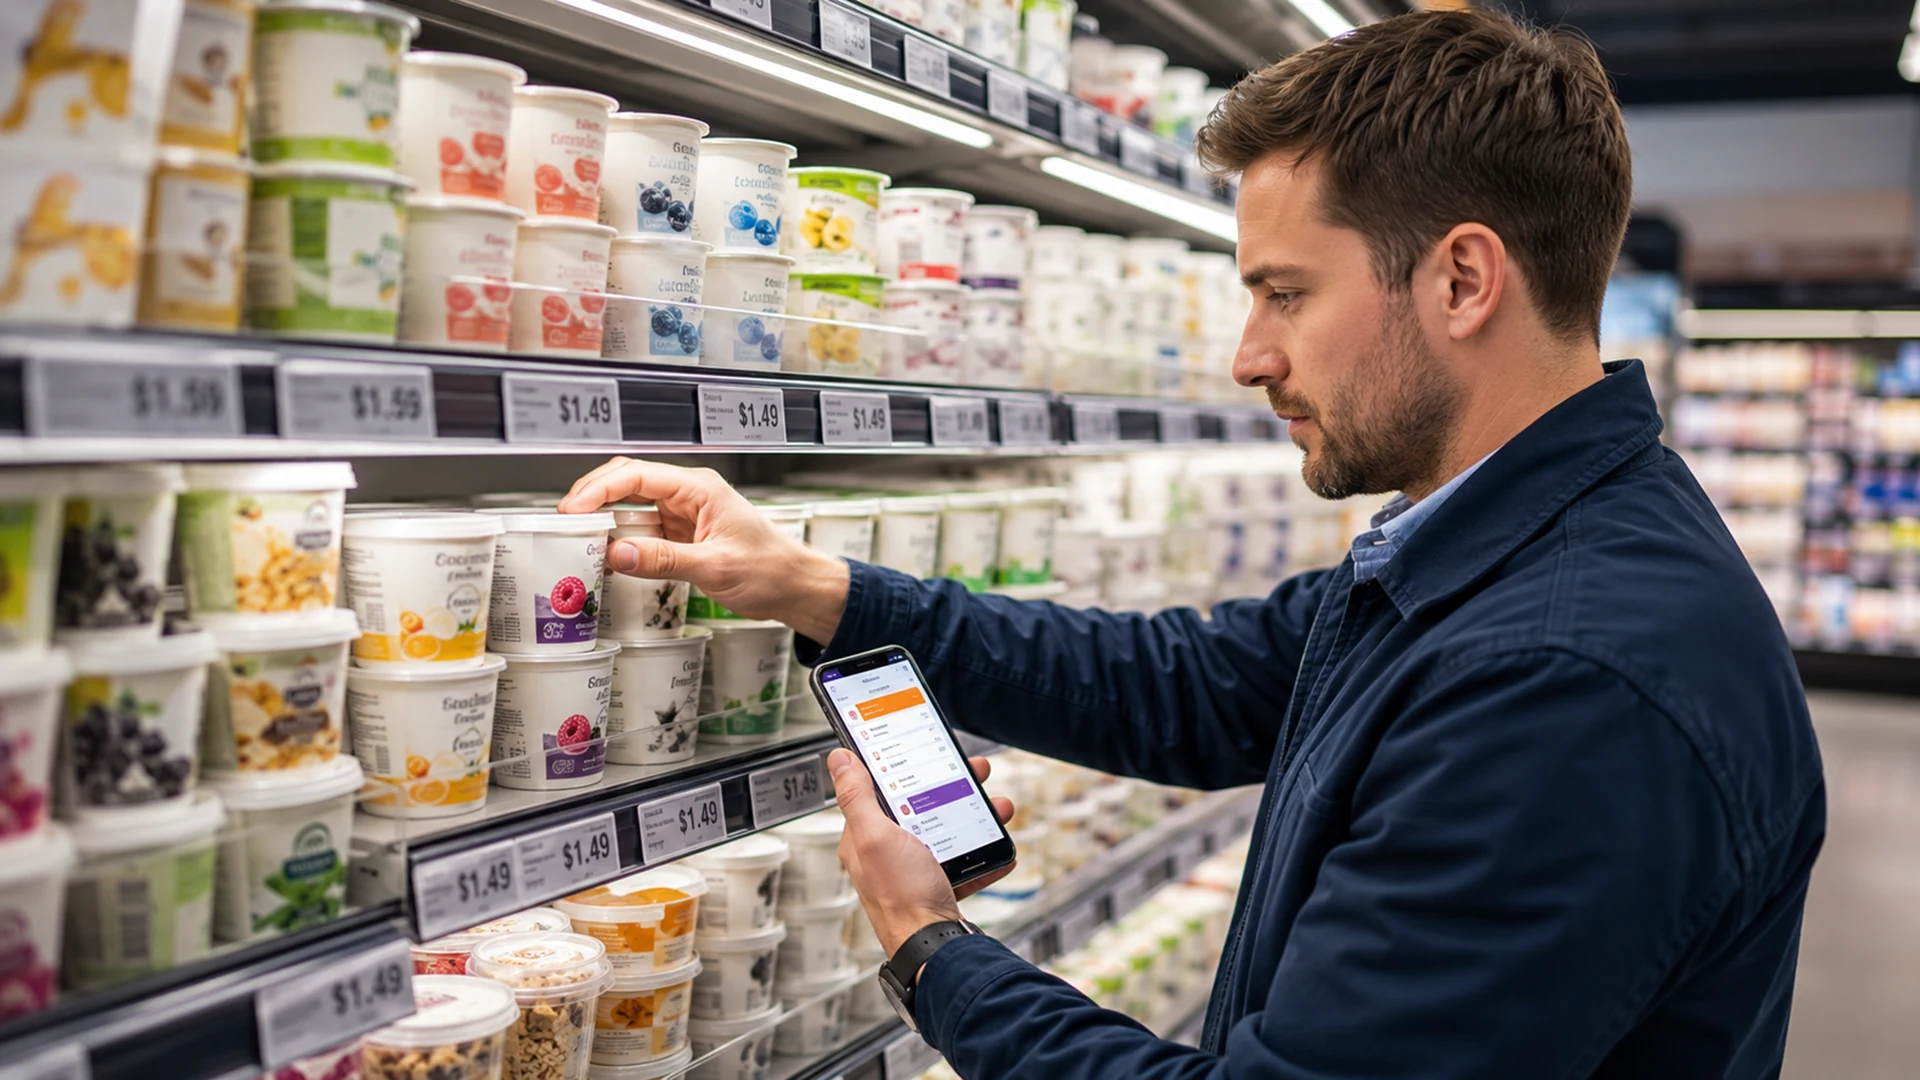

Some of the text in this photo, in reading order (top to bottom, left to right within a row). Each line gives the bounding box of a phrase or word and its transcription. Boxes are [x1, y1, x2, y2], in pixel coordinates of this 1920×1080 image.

[559, 394, 611, 425] $1.49
[739, 402, 779, 428] $1.49
[853, 407, 886, 431] $1.49
[783, 769, 819, 801] $1.49
[679, 800, 718, 835] $1.49
[562, 831, 611, 871] $1.49
[457, 861, 511, 903] $1.49
[331, 962, 403, 1016] $1.49
